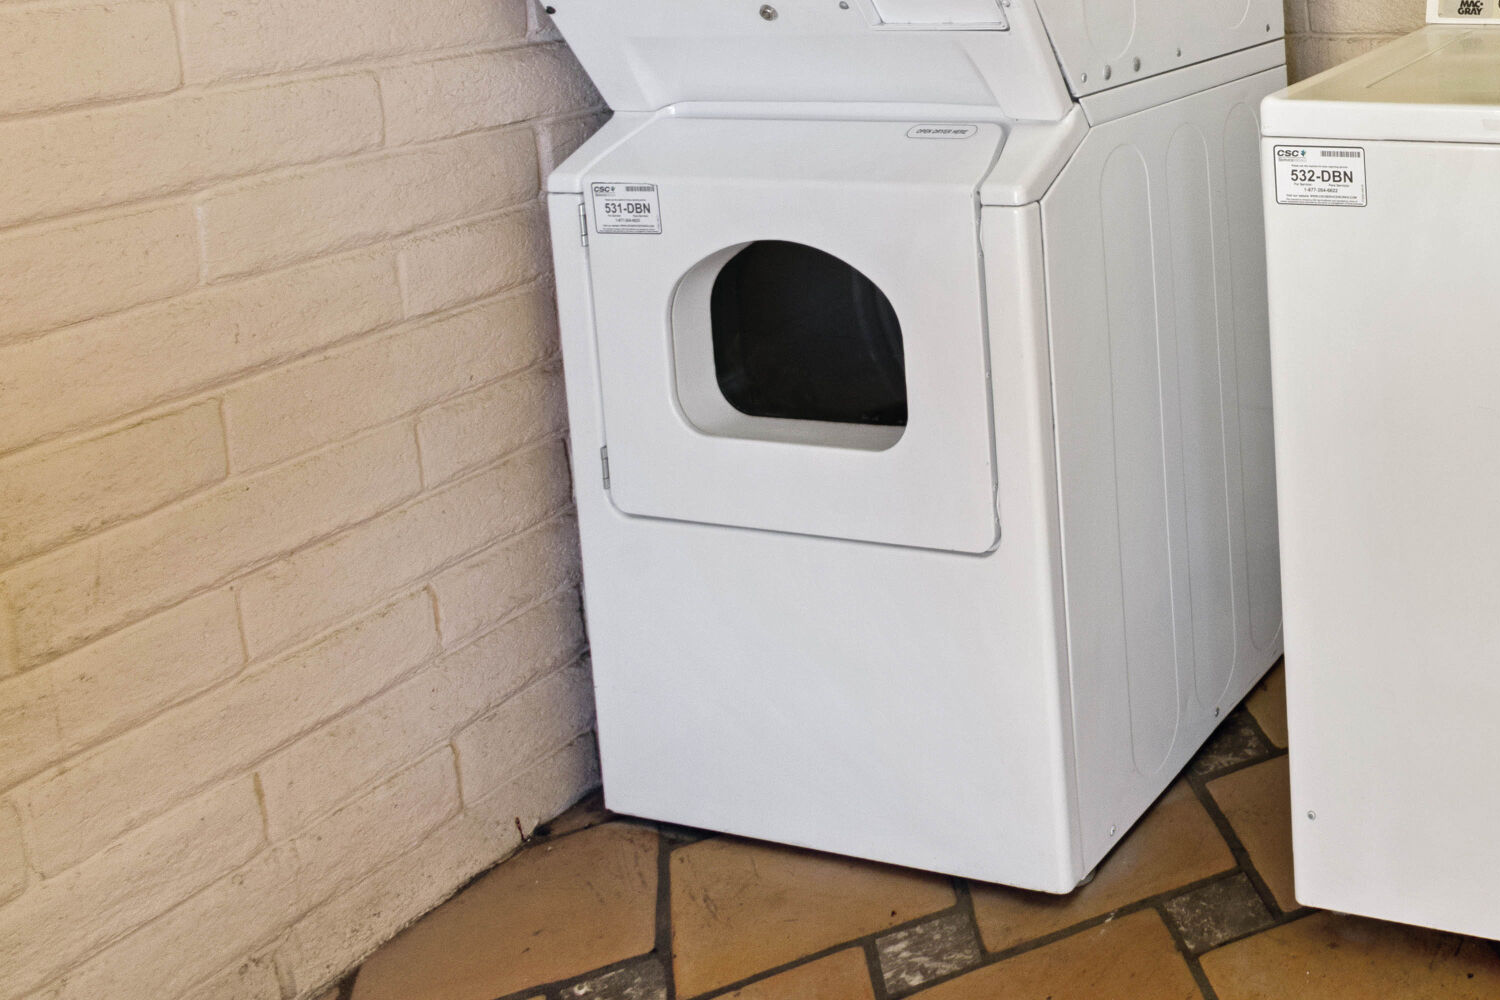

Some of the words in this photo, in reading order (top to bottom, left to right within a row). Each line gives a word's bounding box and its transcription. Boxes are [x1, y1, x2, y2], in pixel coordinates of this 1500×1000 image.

[1458, 7, 1482, 15] GRAY
[1291, 169, 1353, 183] 532-DBN
[605, 202, 651, 214] 531-DBN
